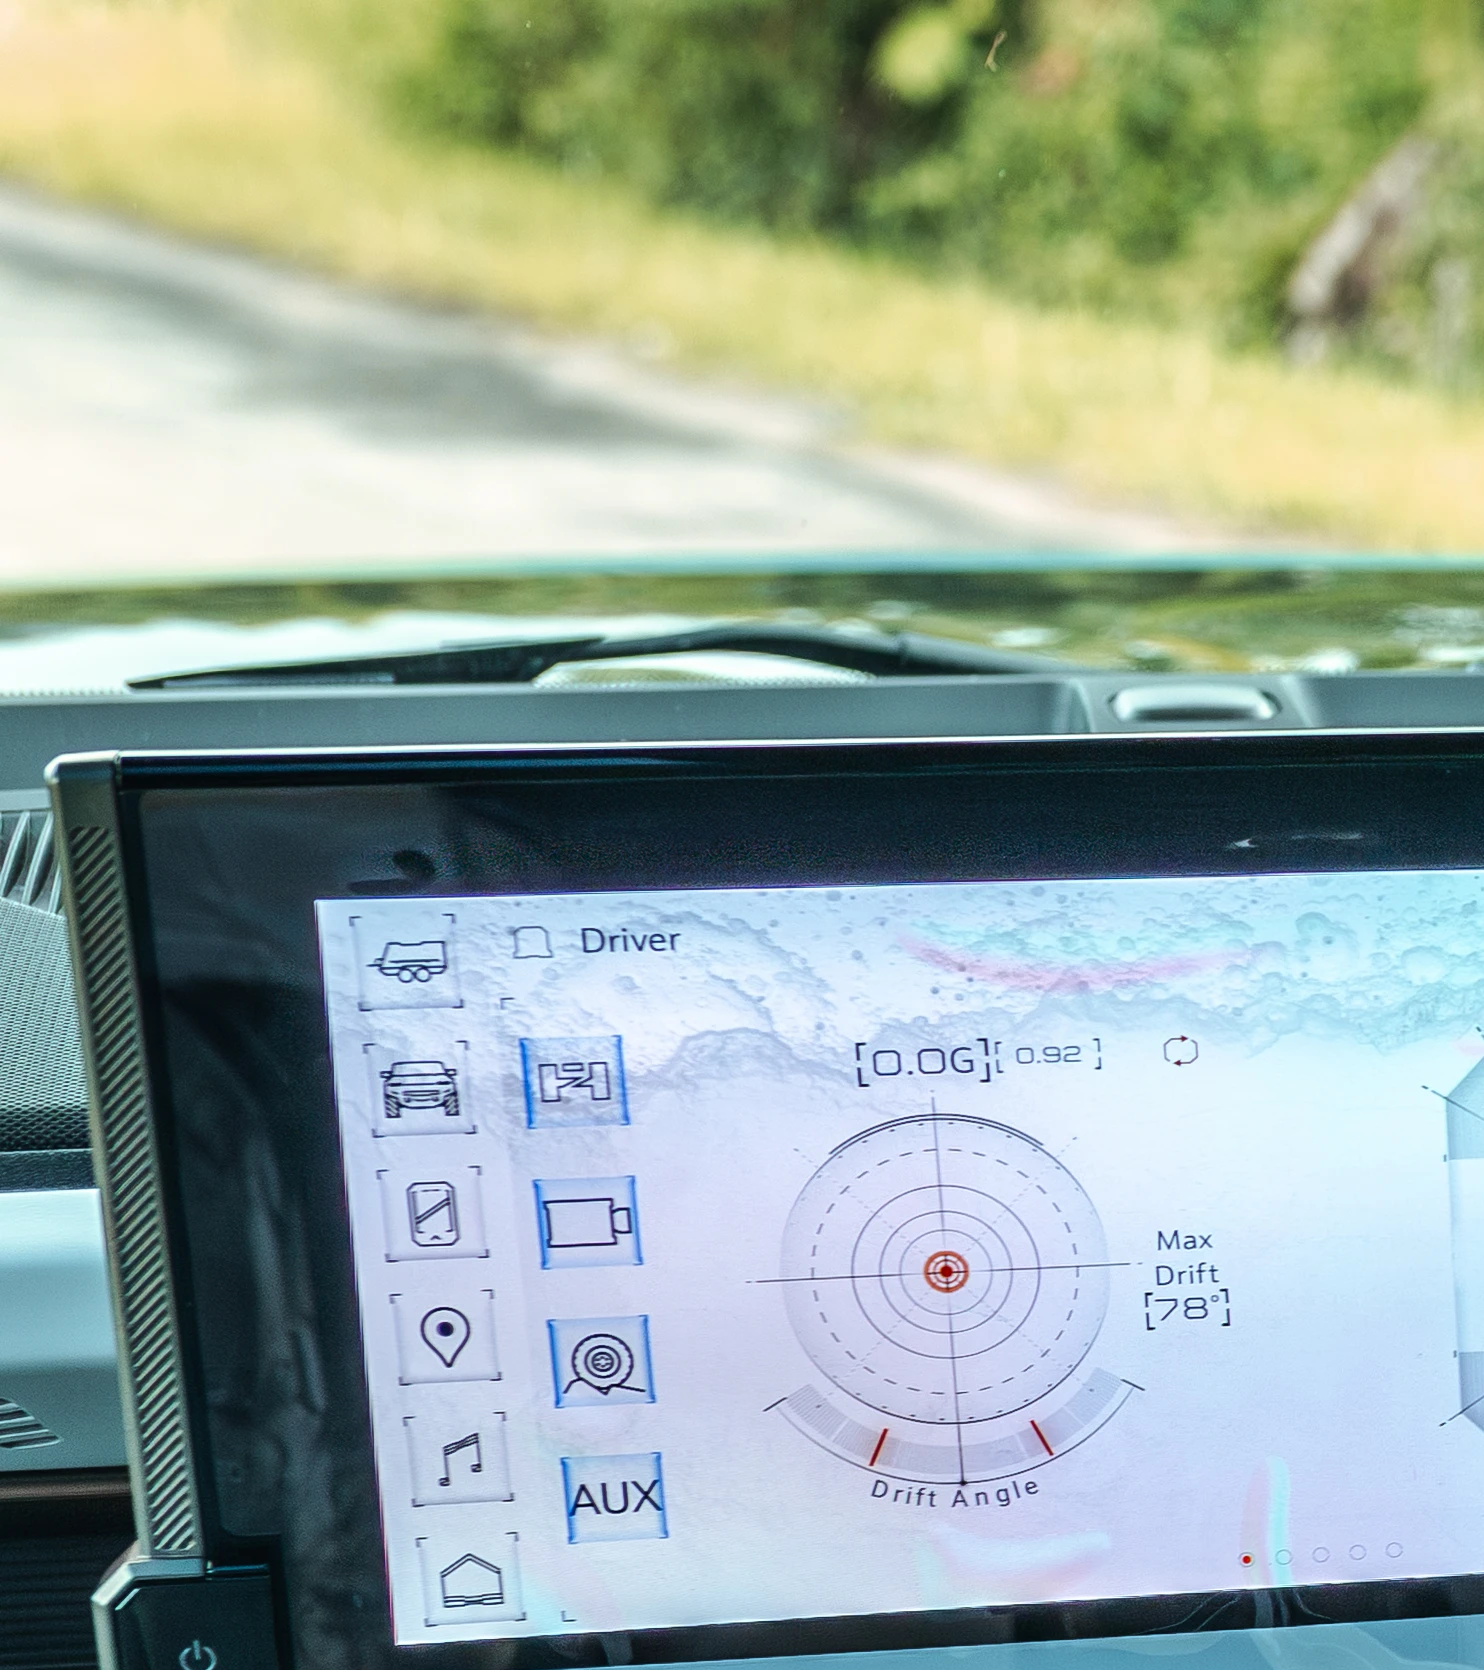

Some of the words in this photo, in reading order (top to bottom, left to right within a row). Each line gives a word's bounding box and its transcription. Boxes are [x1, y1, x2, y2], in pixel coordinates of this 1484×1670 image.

[580, 926, 681, 955] Driver
[1156, 1229, 1214, 1252] Max
[1155, 1261, 1220, 1287] Drift
[568, 1480, 662, 1519] AUX
[870, 1478, 937, 1508] Drift
[951, 1477, 1041, 1508] Angle
